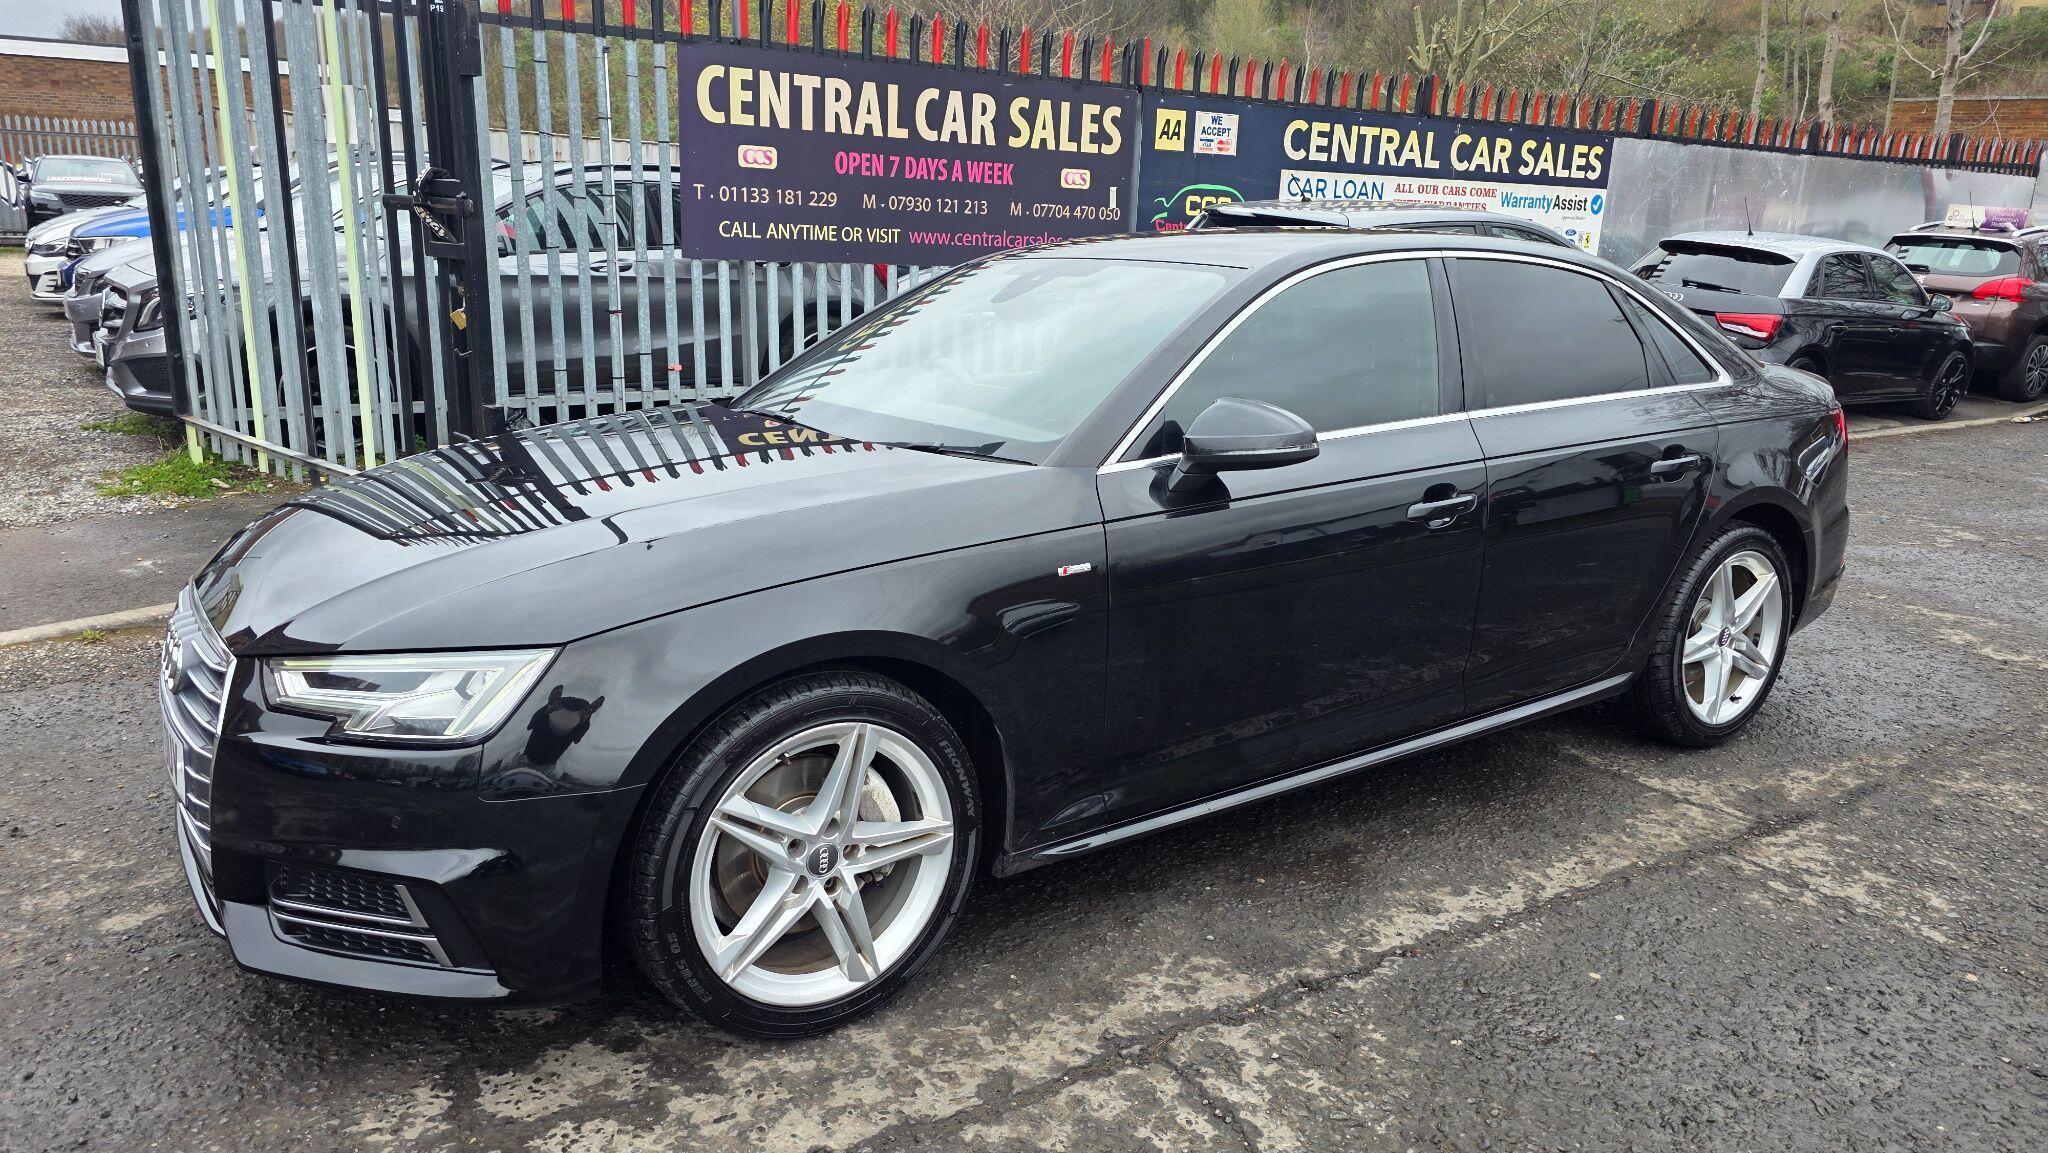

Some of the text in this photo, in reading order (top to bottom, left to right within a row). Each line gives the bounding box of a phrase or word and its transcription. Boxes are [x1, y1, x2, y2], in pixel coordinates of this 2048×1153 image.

[696, 64, 1122, 155] CENTRAL CAR SALES
[1211, 115, 1223, 126] WE
[1158, 118, 1182, 141] AA
[1200, 126, 1232, 137] ACCEPT
[1283, 119, 1604, 181] CENTRAL CAR SALES
[834, 151, 1014, 185] OPEN 7 DAYS A WEEK
[1287, 176, 1384, 201] CAR LOAN
[1394, 183, 1498, 198] ALL OUR CARS COME
[719, 185, 769, 204] 01133
[776, 189, 802, 206] 181
[808, 191, 838, 208] 229
[888, 195, 931, 212] 07930
[936, 198, 958, 214] 121
[964, 199, 988, 215] 213
[1033, 203, 1070, 219] 07704
[1073, 206, 1095, 220] 470
[1098, 207, 1120, 221] 050
[718, 220, 761, 239] CALL
[766, 222, 837, 242] ANYTIME
[841, 226, 863, 243] OR
[866, 227, 902, 244] VISIT
[939, 740, 975, 817] FRONWAY
